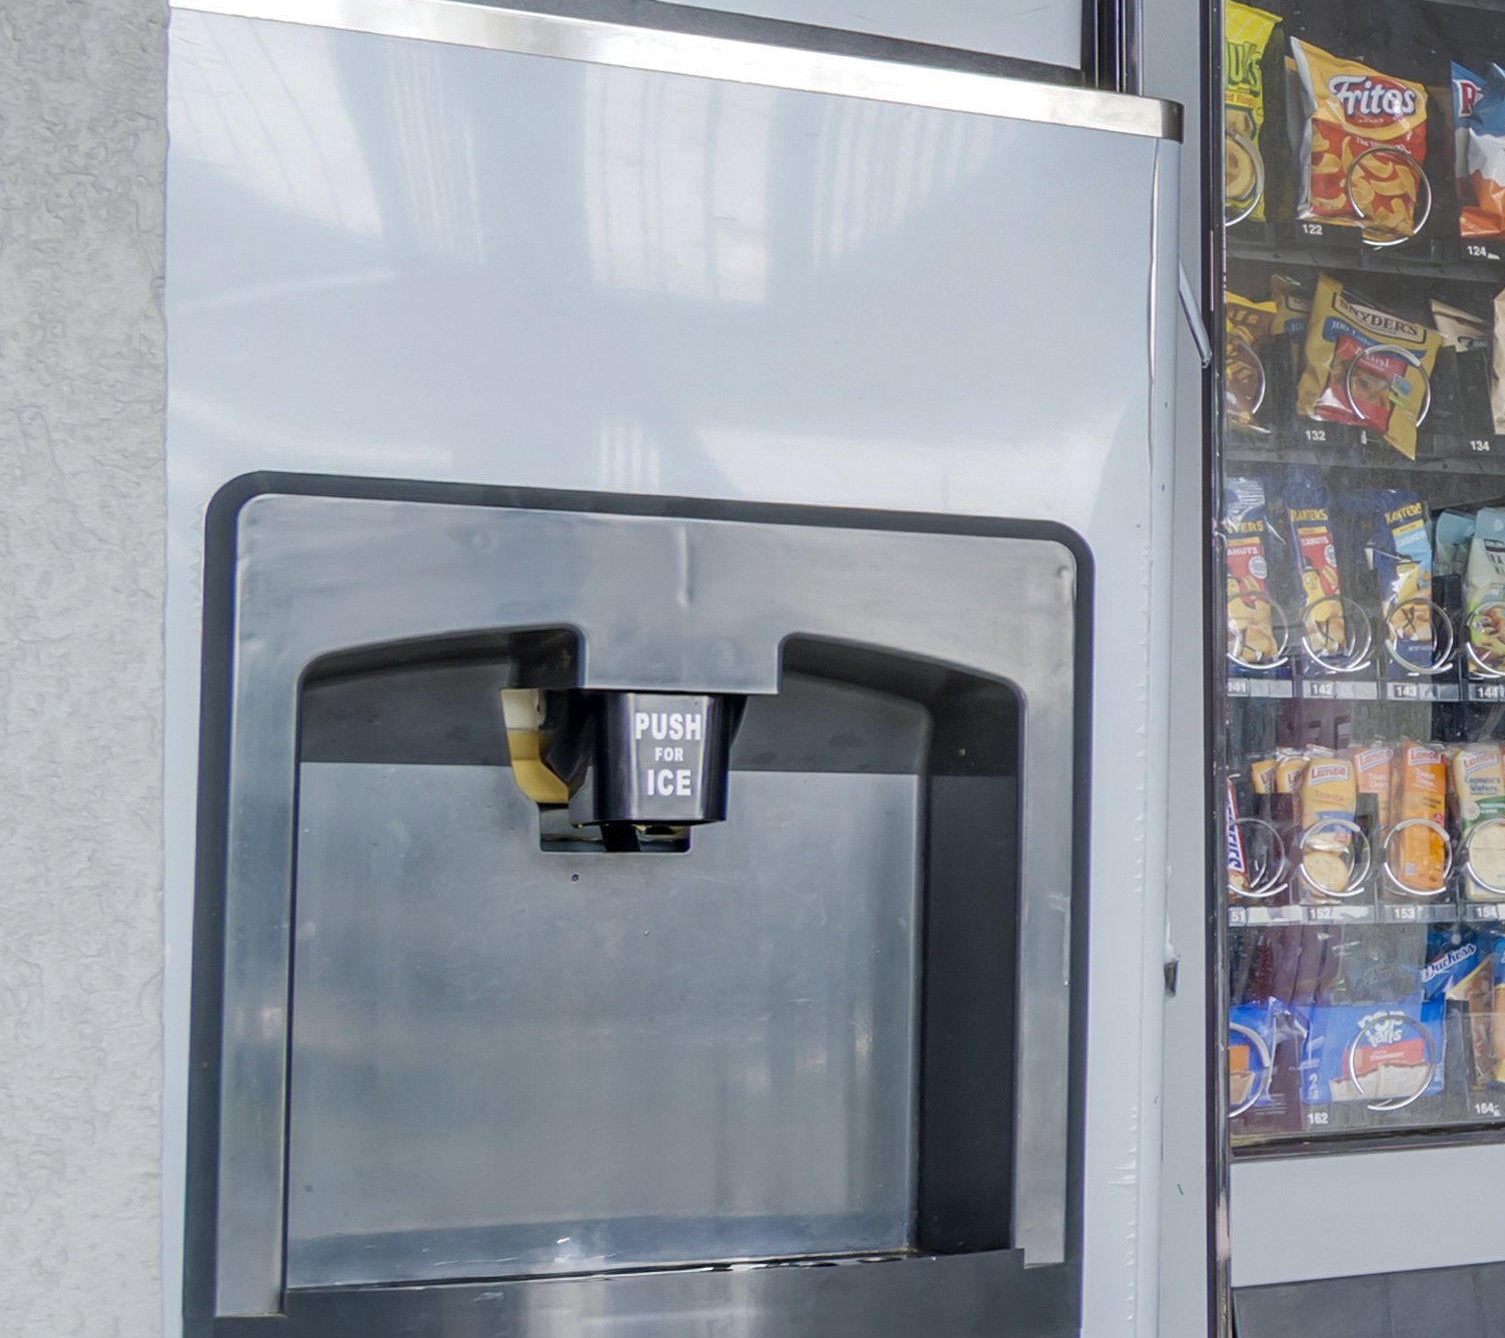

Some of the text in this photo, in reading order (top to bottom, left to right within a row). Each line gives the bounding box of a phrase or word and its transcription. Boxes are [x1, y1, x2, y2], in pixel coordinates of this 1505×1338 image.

[1328, 74, 1416, 116] Fritos
[1302, 224, 1323, 235] 122
[1467, 245, 1487, 257] 124
[1305, 430, 1326, 441] 132
[1470, 440, 1490, 451] 134
[1312, 683, 1333, 695] 142
[1396, 685, 1417, 697] 143
[1478, 686, 1498, 698] 144
[635, 712, 702, 741] PUSH
[655, 747, 684, 762] FOR
[1311, 765, 1346, 779] Lance
[647, 769, 692, 797] ICE
[1231, 912, 1246, 923] 51
[1310, 908, 1331, 920] 152
[1394, 908, 1415, 919] 153
[1425, 944, 1476, 979] Duchess
[1307, 1113, 1329, 1124] 162
